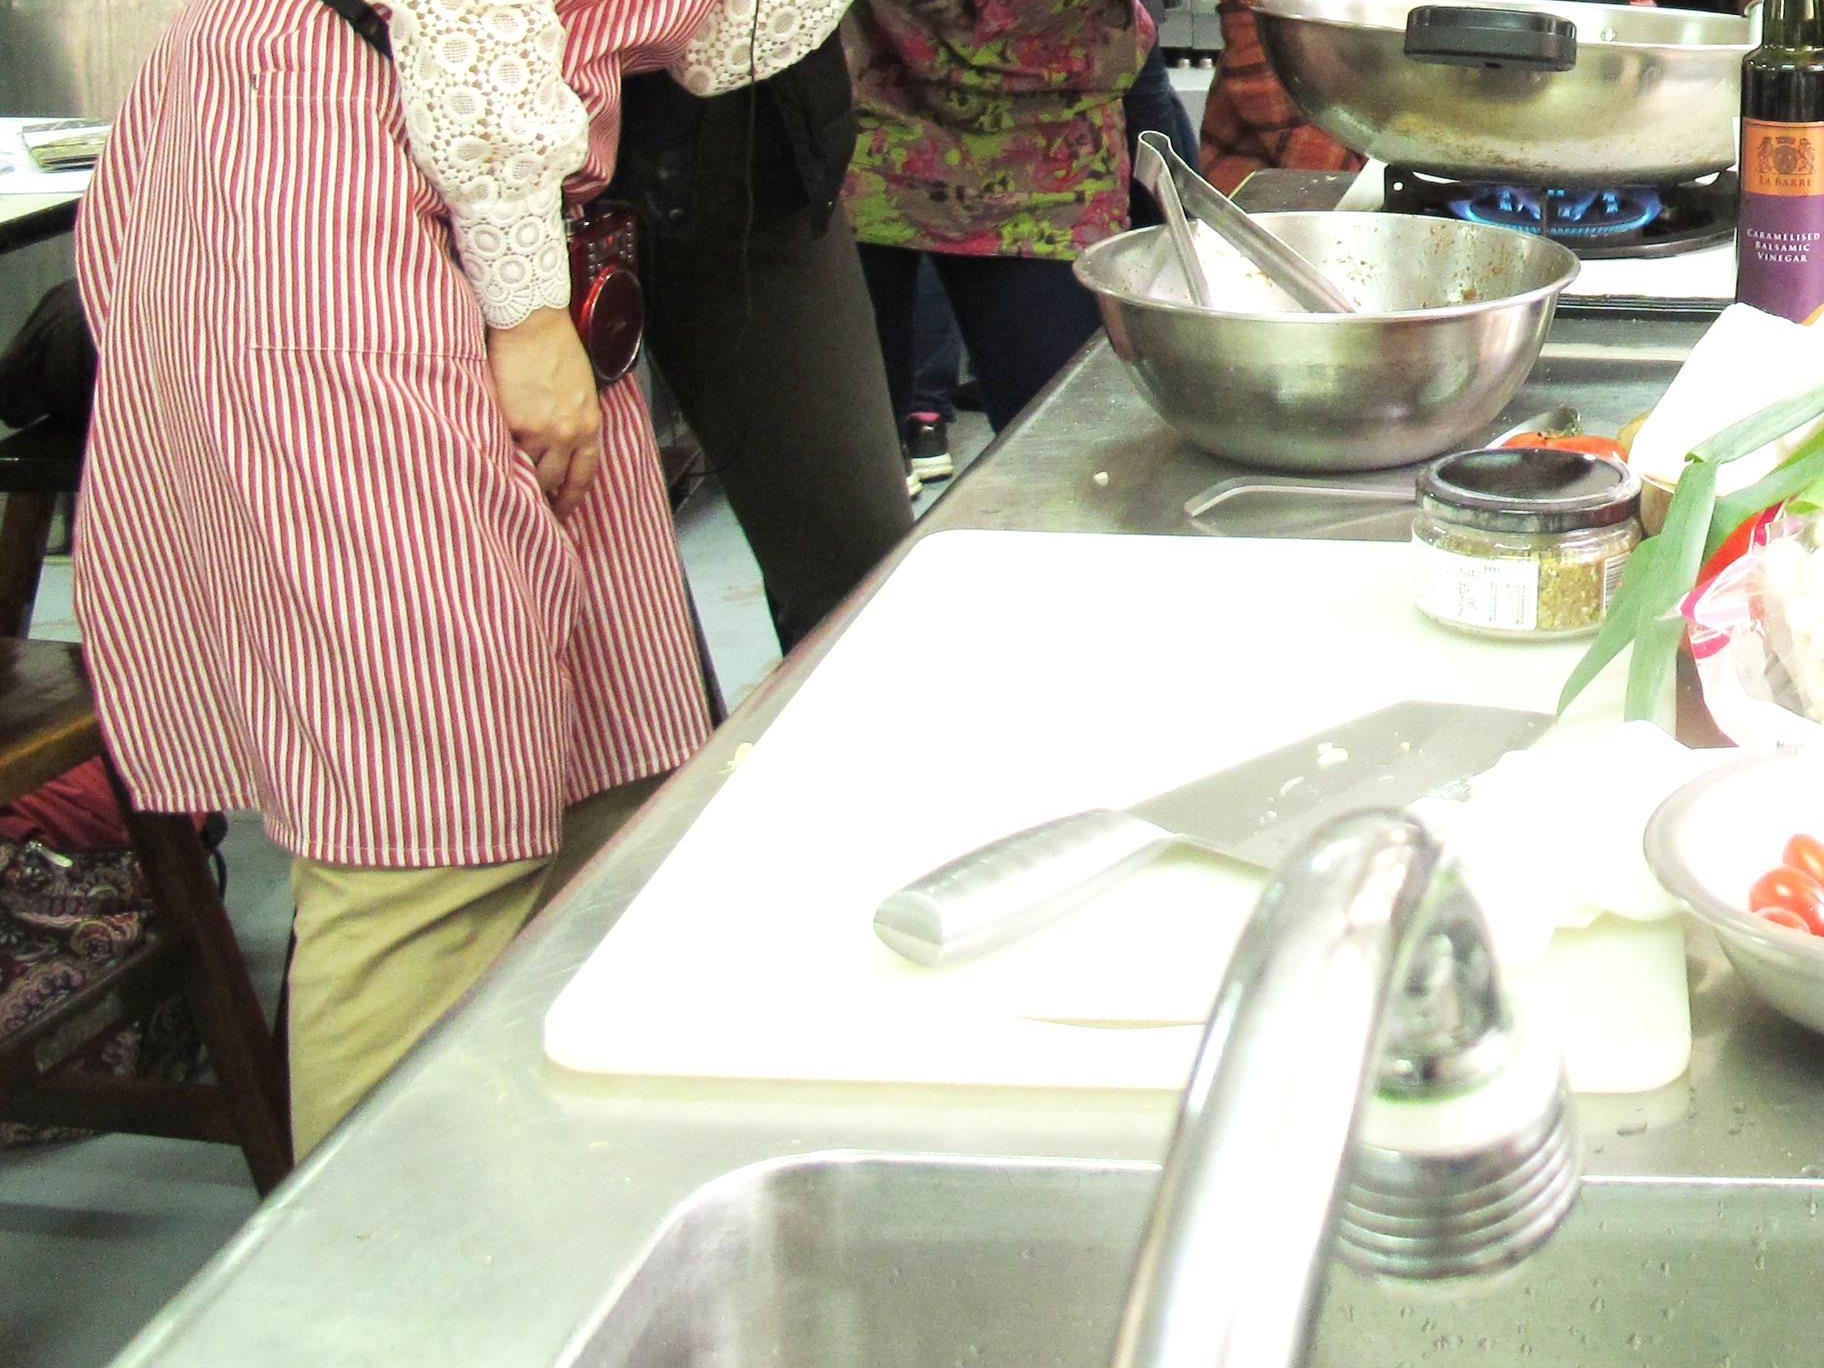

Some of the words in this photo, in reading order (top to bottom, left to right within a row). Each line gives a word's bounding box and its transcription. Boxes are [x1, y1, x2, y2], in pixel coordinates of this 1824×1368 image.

[1759, 175, 1772, 186] LA
[1775, 177, 1812, 188] BARRE
[1746, 228, 1821, 241] CARAMELISED
[1755, 240, 1811, 252] BALSAMIC
[1757, 251, 1808, 263] VINEGAR
